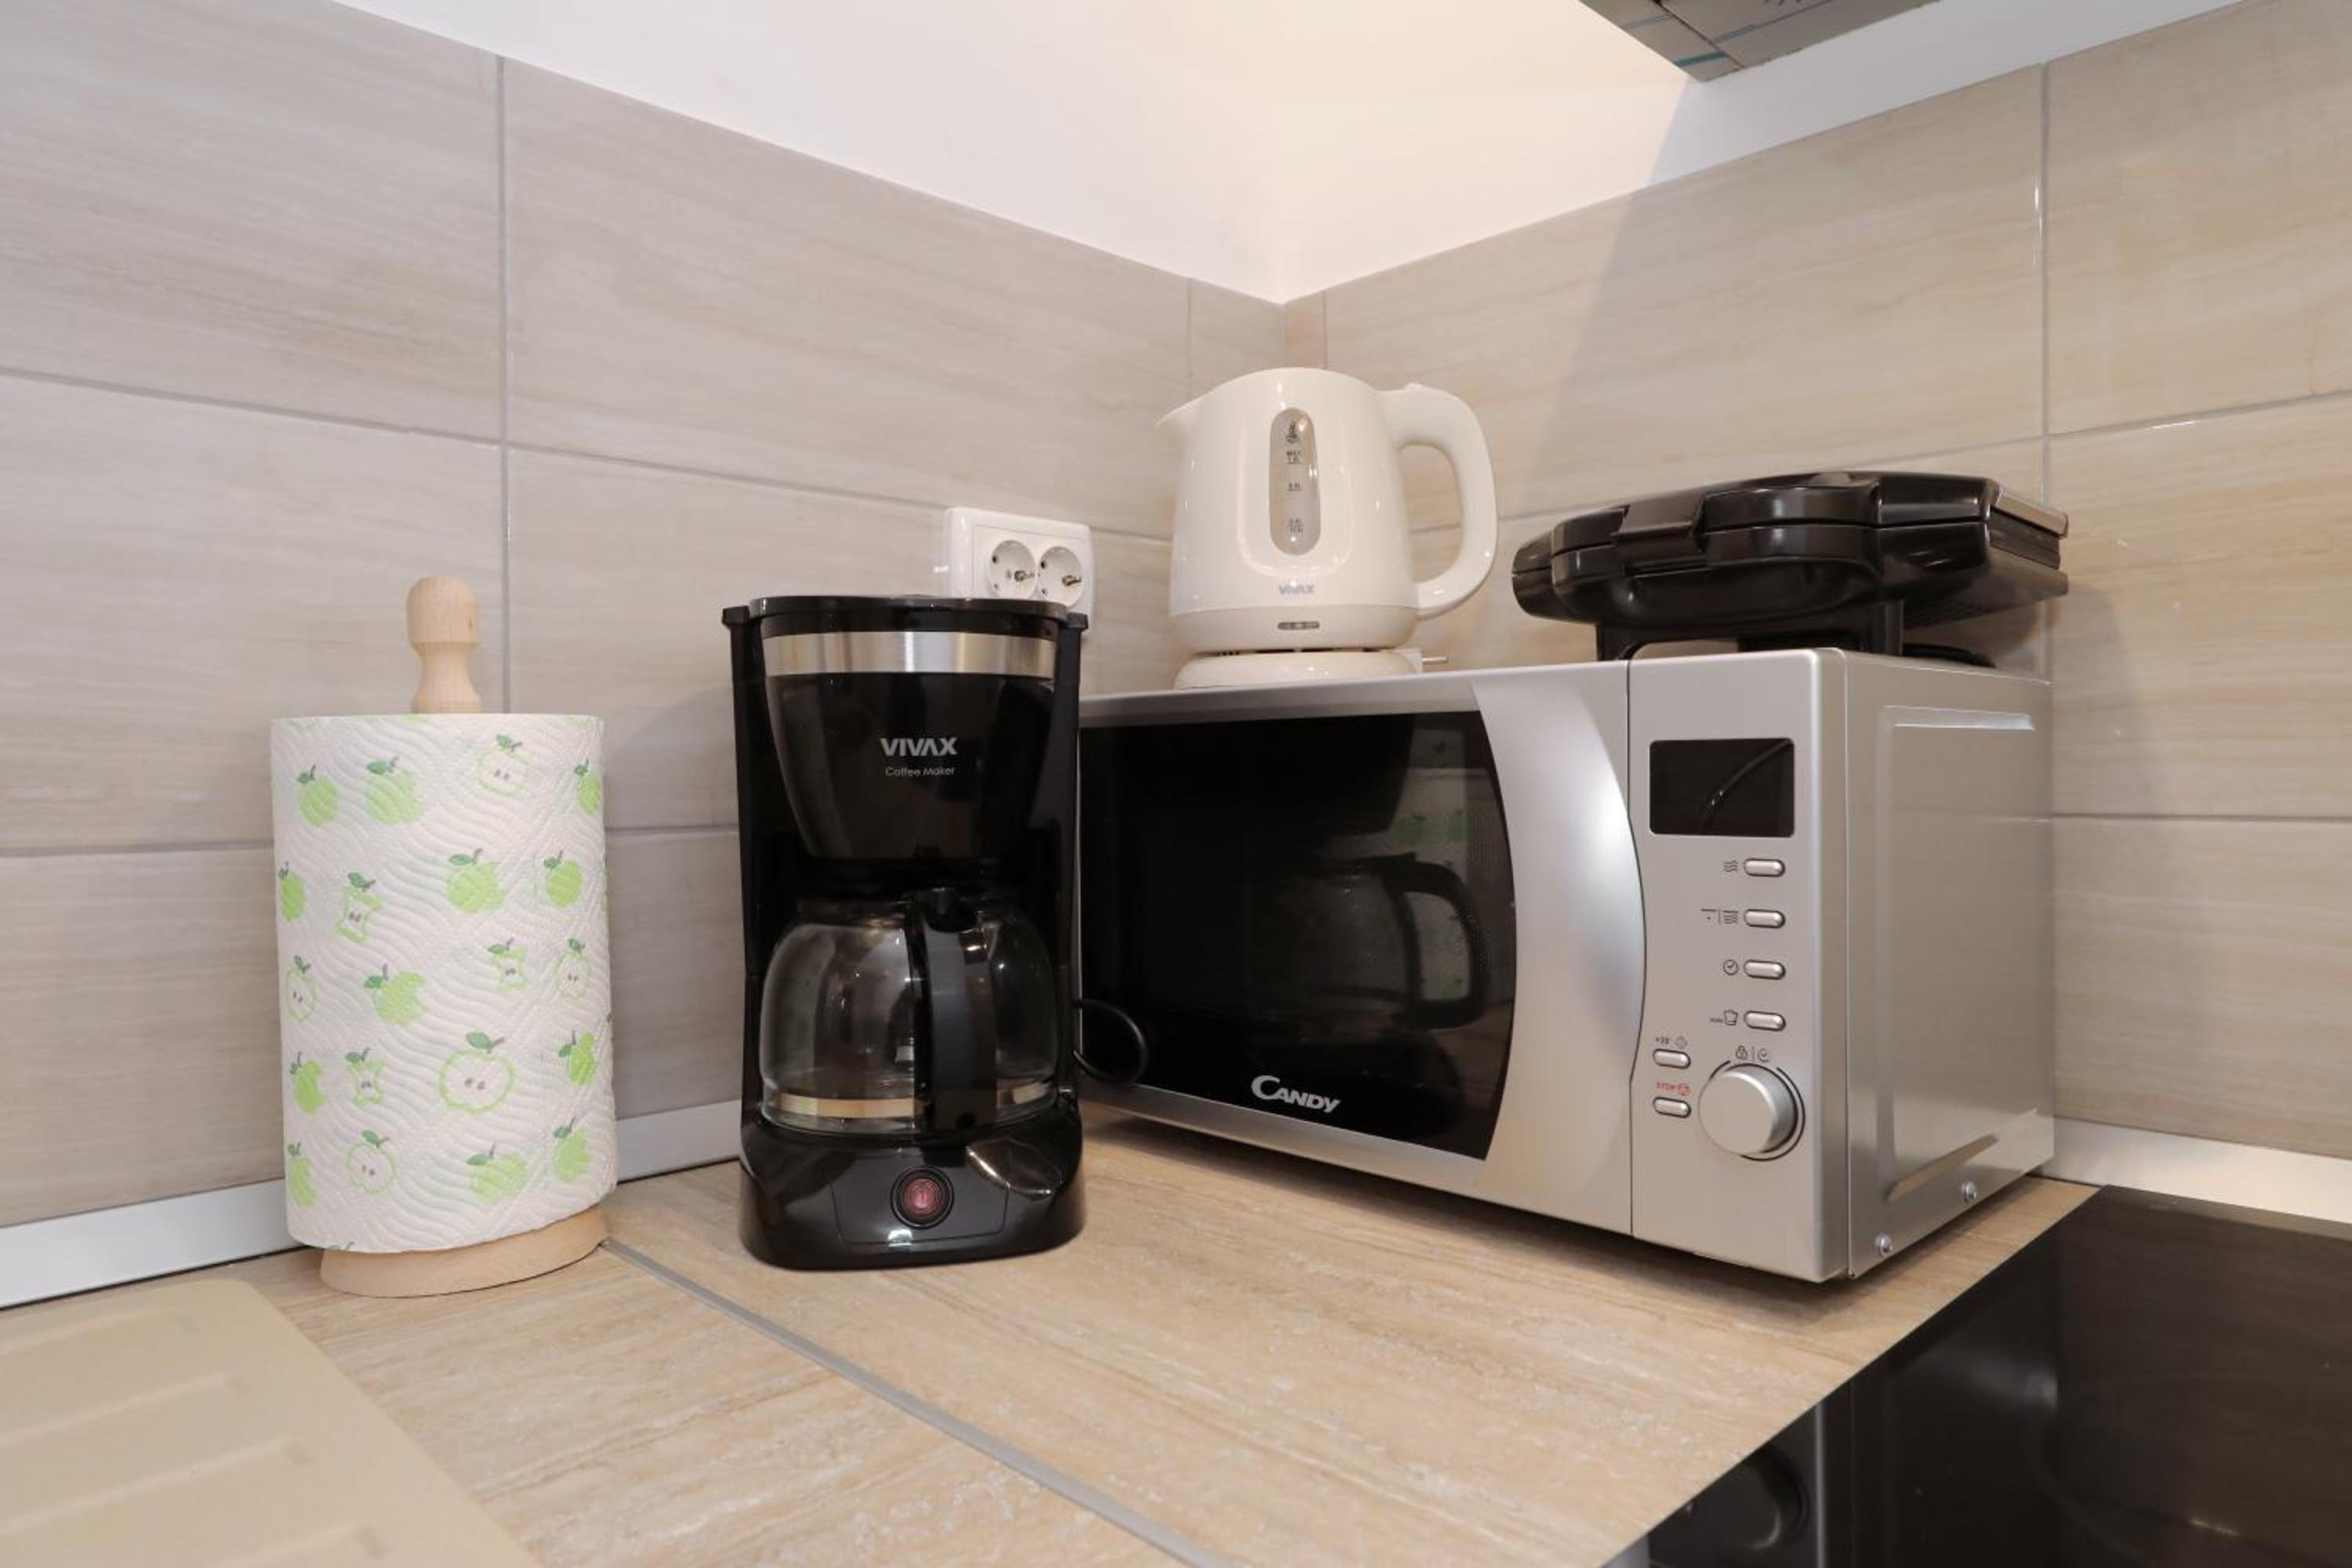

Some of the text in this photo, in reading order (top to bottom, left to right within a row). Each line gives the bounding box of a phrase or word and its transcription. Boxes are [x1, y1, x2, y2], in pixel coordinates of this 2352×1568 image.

[880, 738, 958, 757] VIVAX
[885, 766, 955, 777] Coffee Maker
